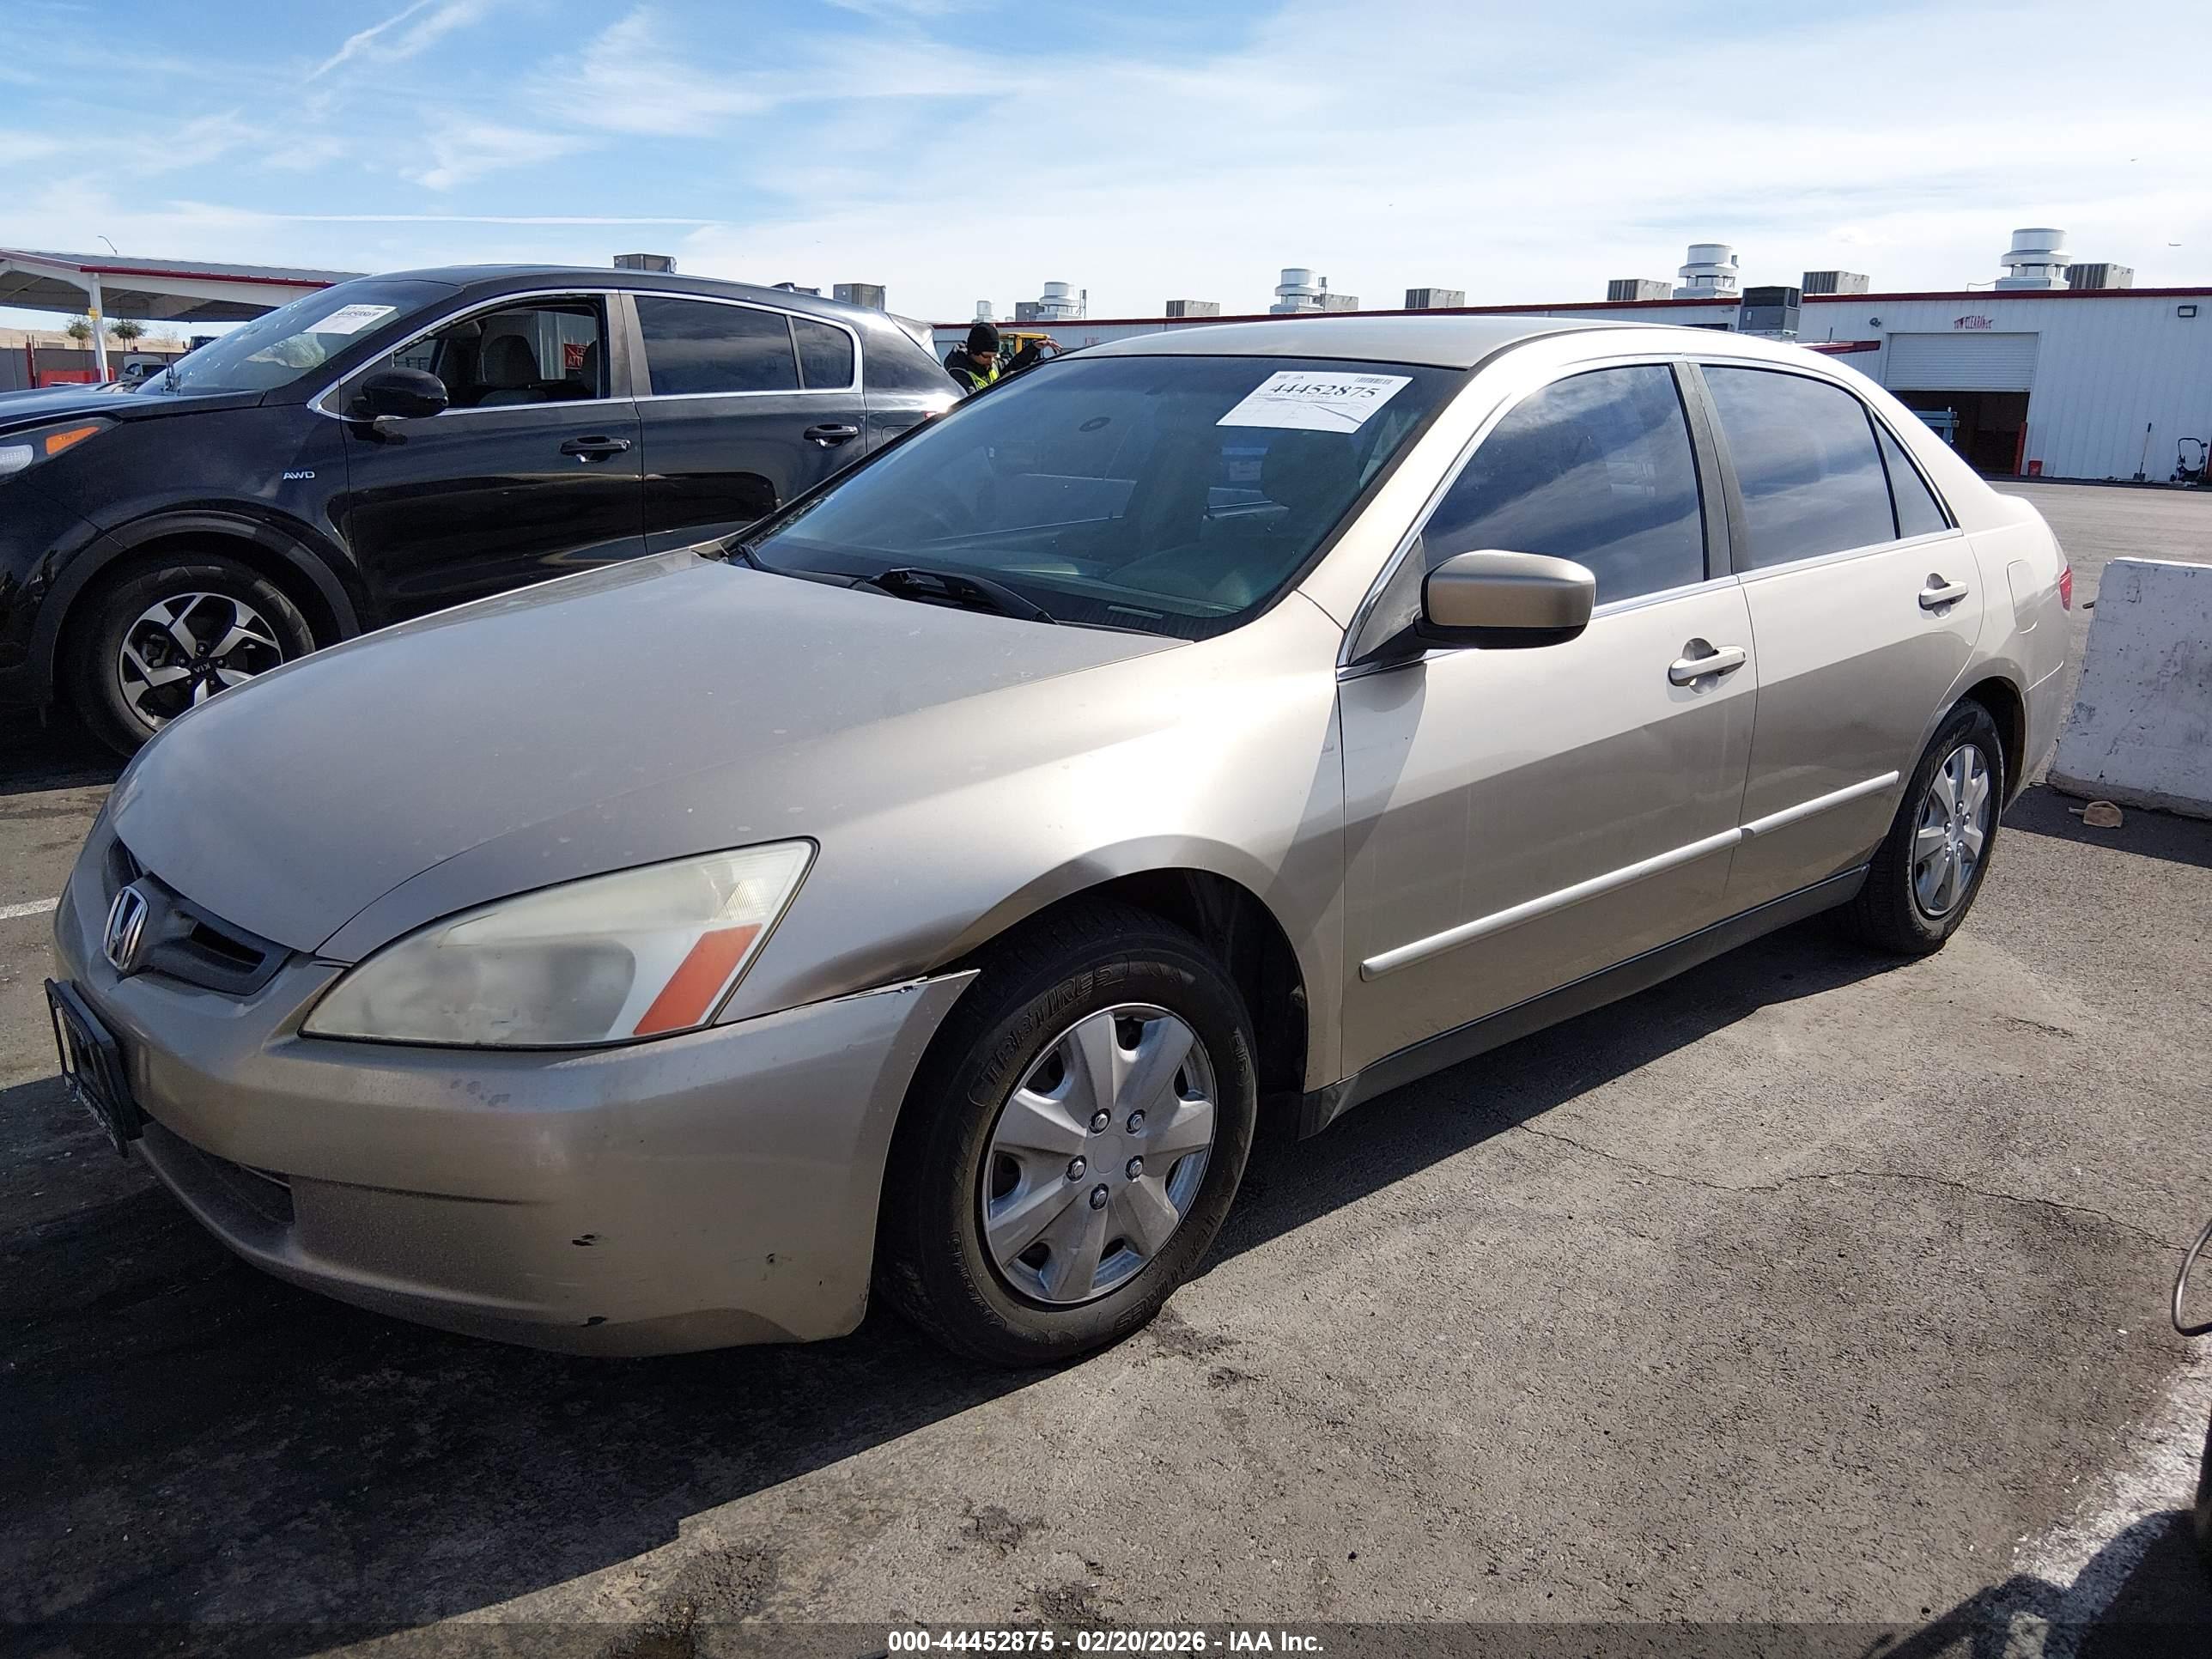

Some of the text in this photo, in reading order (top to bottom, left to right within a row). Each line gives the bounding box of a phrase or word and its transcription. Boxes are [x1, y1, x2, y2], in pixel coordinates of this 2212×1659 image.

[1270, 383, 1382, 399] 44452875
[283, 471, 315, 479] AWD
[193, 662, 211, 673] KIA
